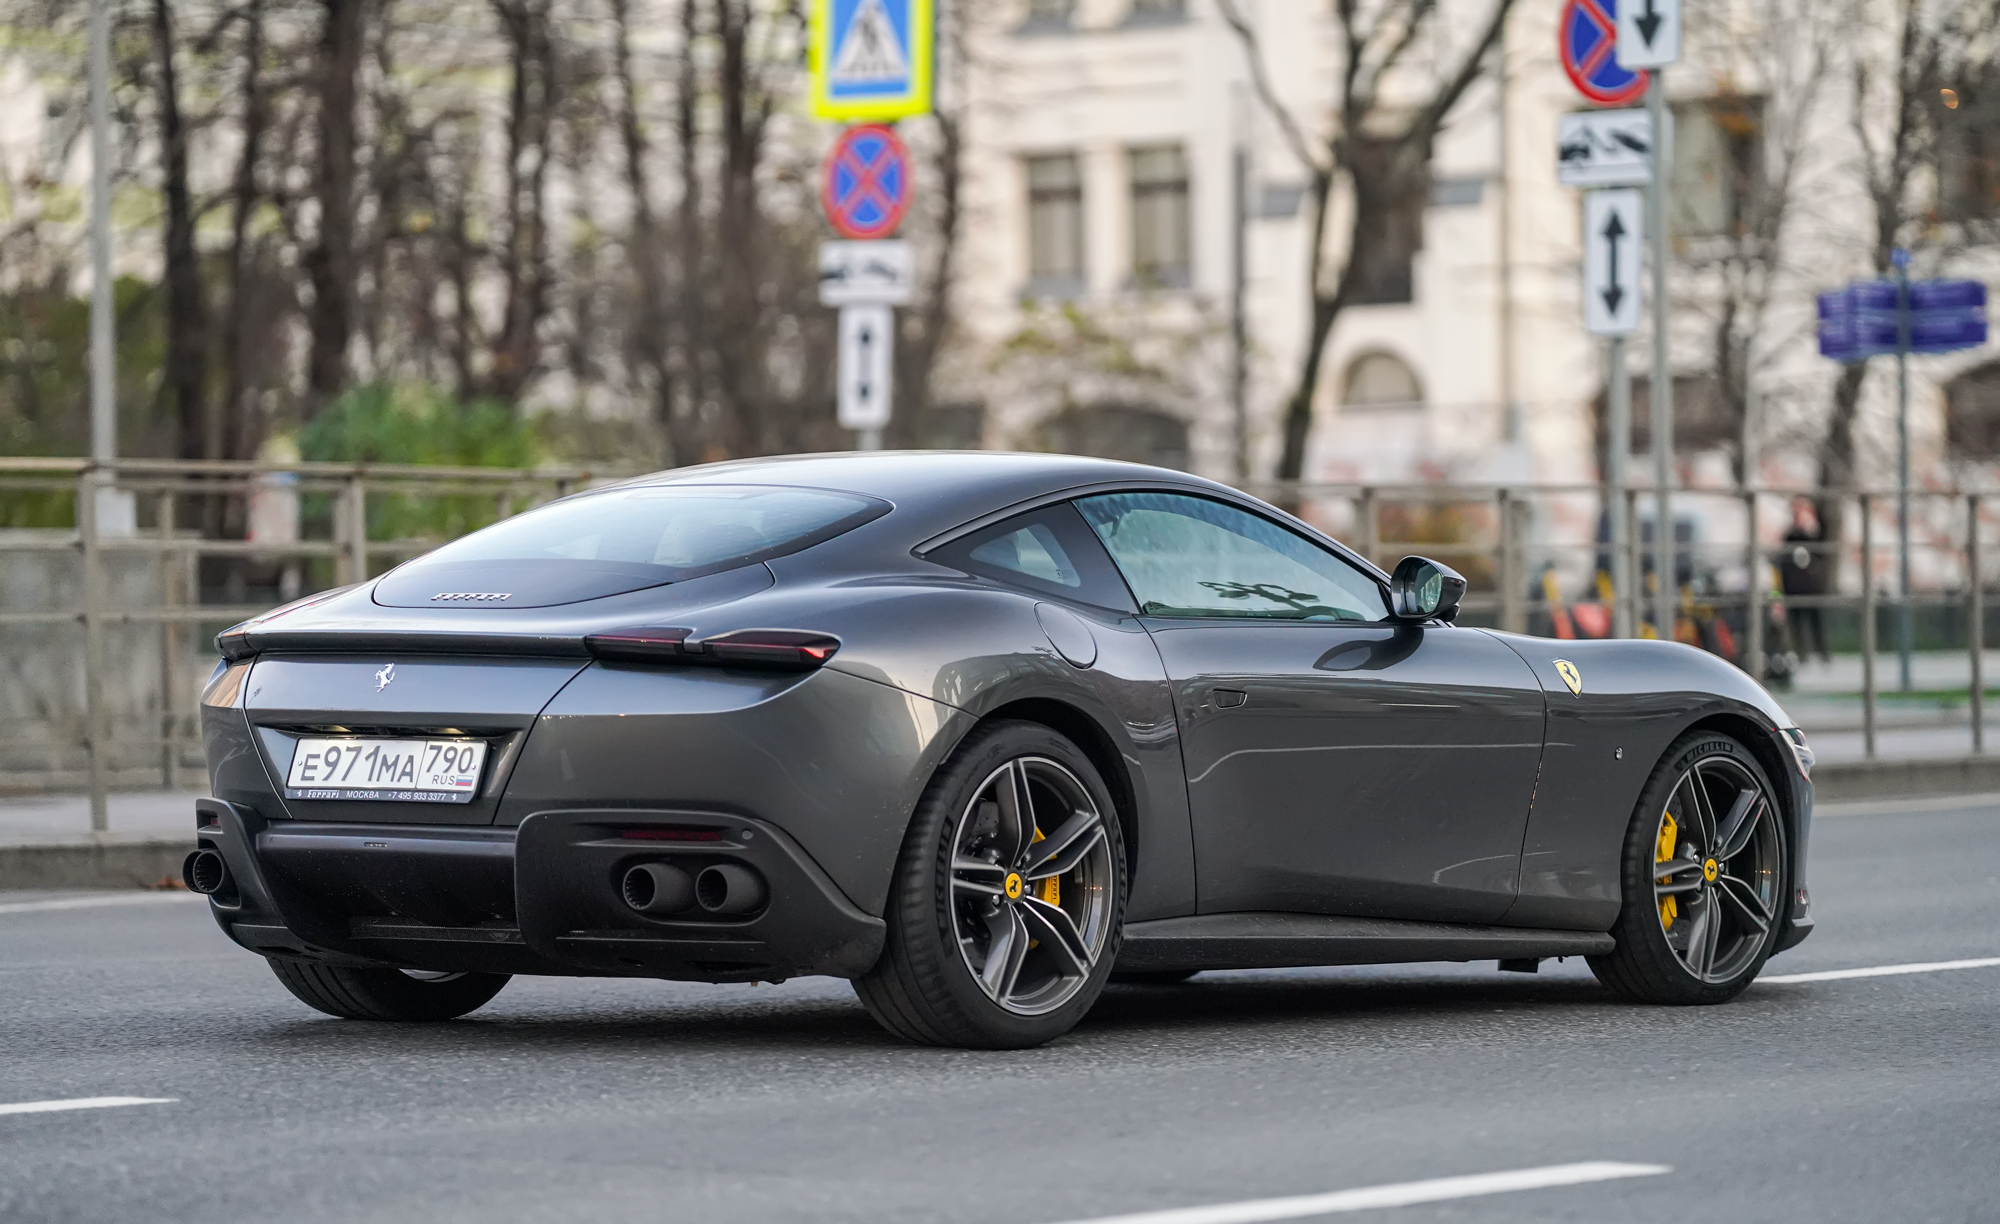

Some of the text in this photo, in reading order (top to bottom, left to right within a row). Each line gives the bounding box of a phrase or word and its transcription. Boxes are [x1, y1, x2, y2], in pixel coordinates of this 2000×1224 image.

[426, 745, 474, 774] 790
[432, 775, 456, 786] RUS
[307, 789, 340, 798] Ferrari
[388, 791, 398, 799] +7
[398, 792, 412, 800] 495
[413, 792, 427, 800] 933
[427, 793, 447, 801] 3377
